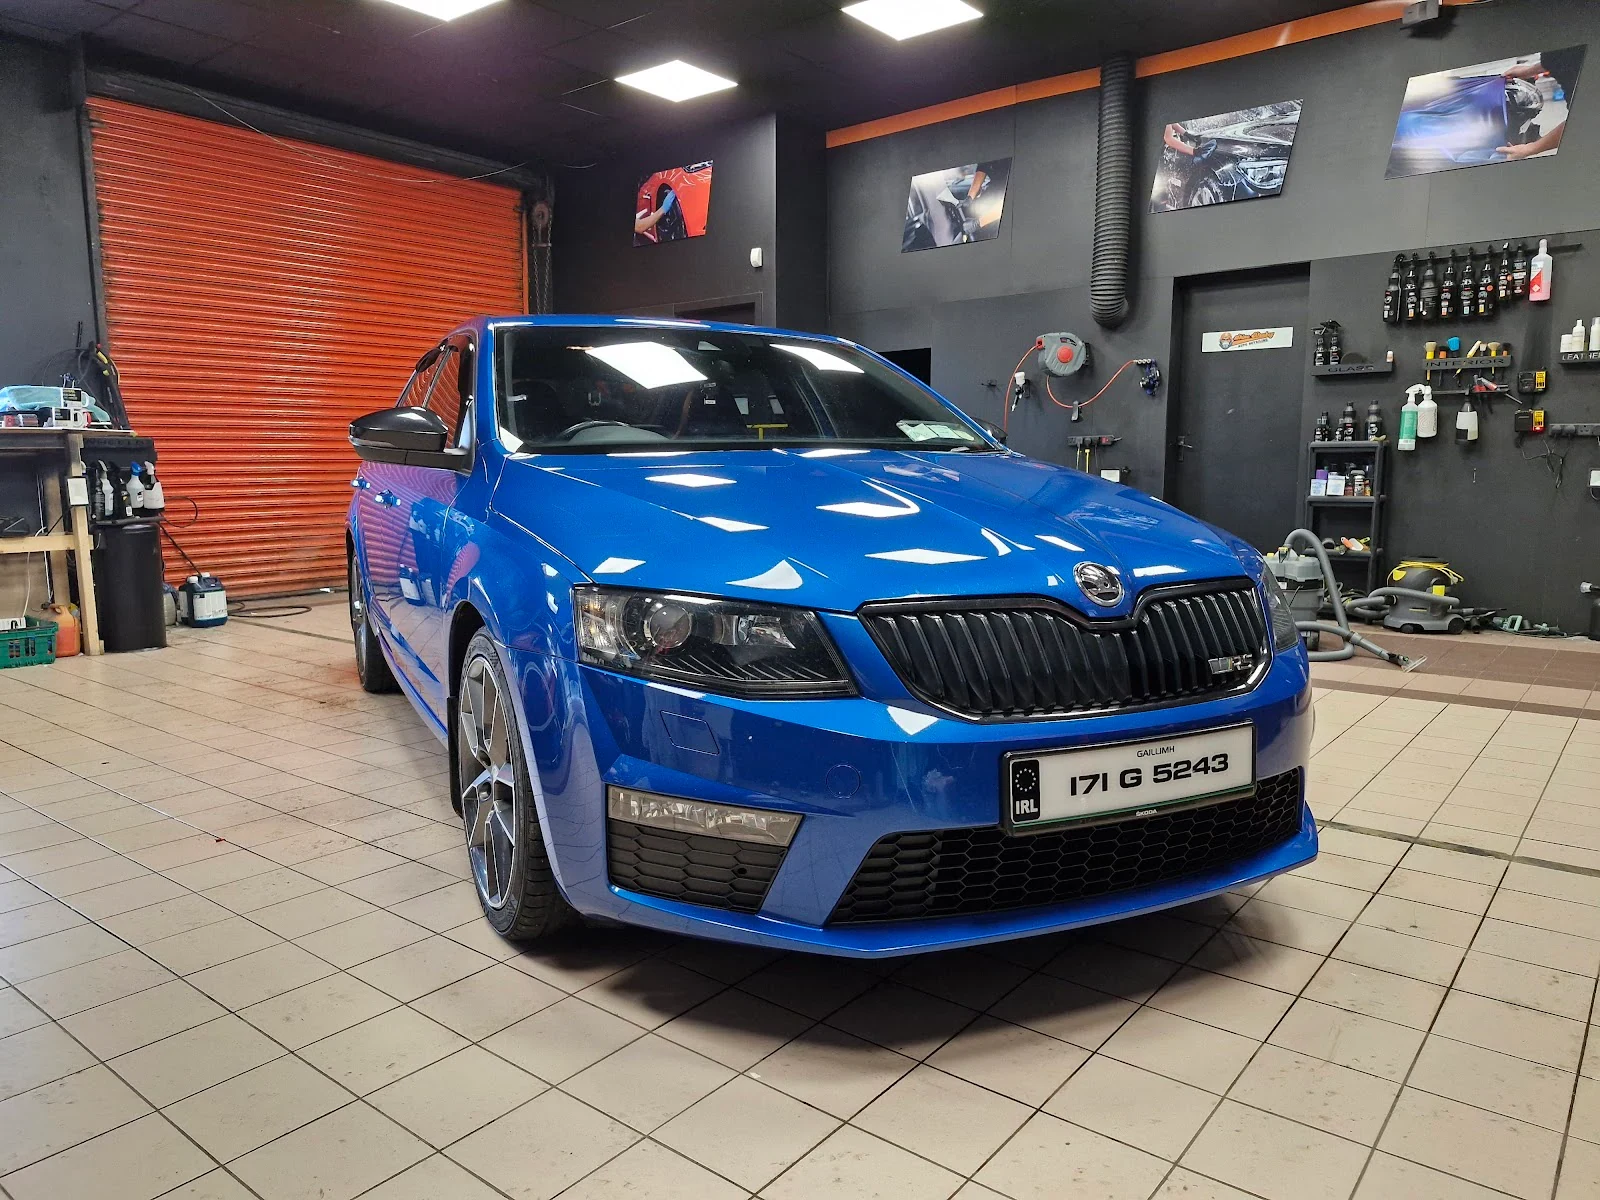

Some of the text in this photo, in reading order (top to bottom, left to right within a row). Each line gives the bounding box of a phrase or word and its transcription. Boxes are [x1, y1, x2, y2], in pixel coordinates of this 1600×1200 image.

[1327, 365, 1375, 373] GLASS
[1426, 358, 1504, 368] INTERIOR
[1136, 745, 1175, 758] GAILLIMH
[1070, 753, 1229, 796] 171 G 5243
[1015, 797, 1039, 815] IRL
